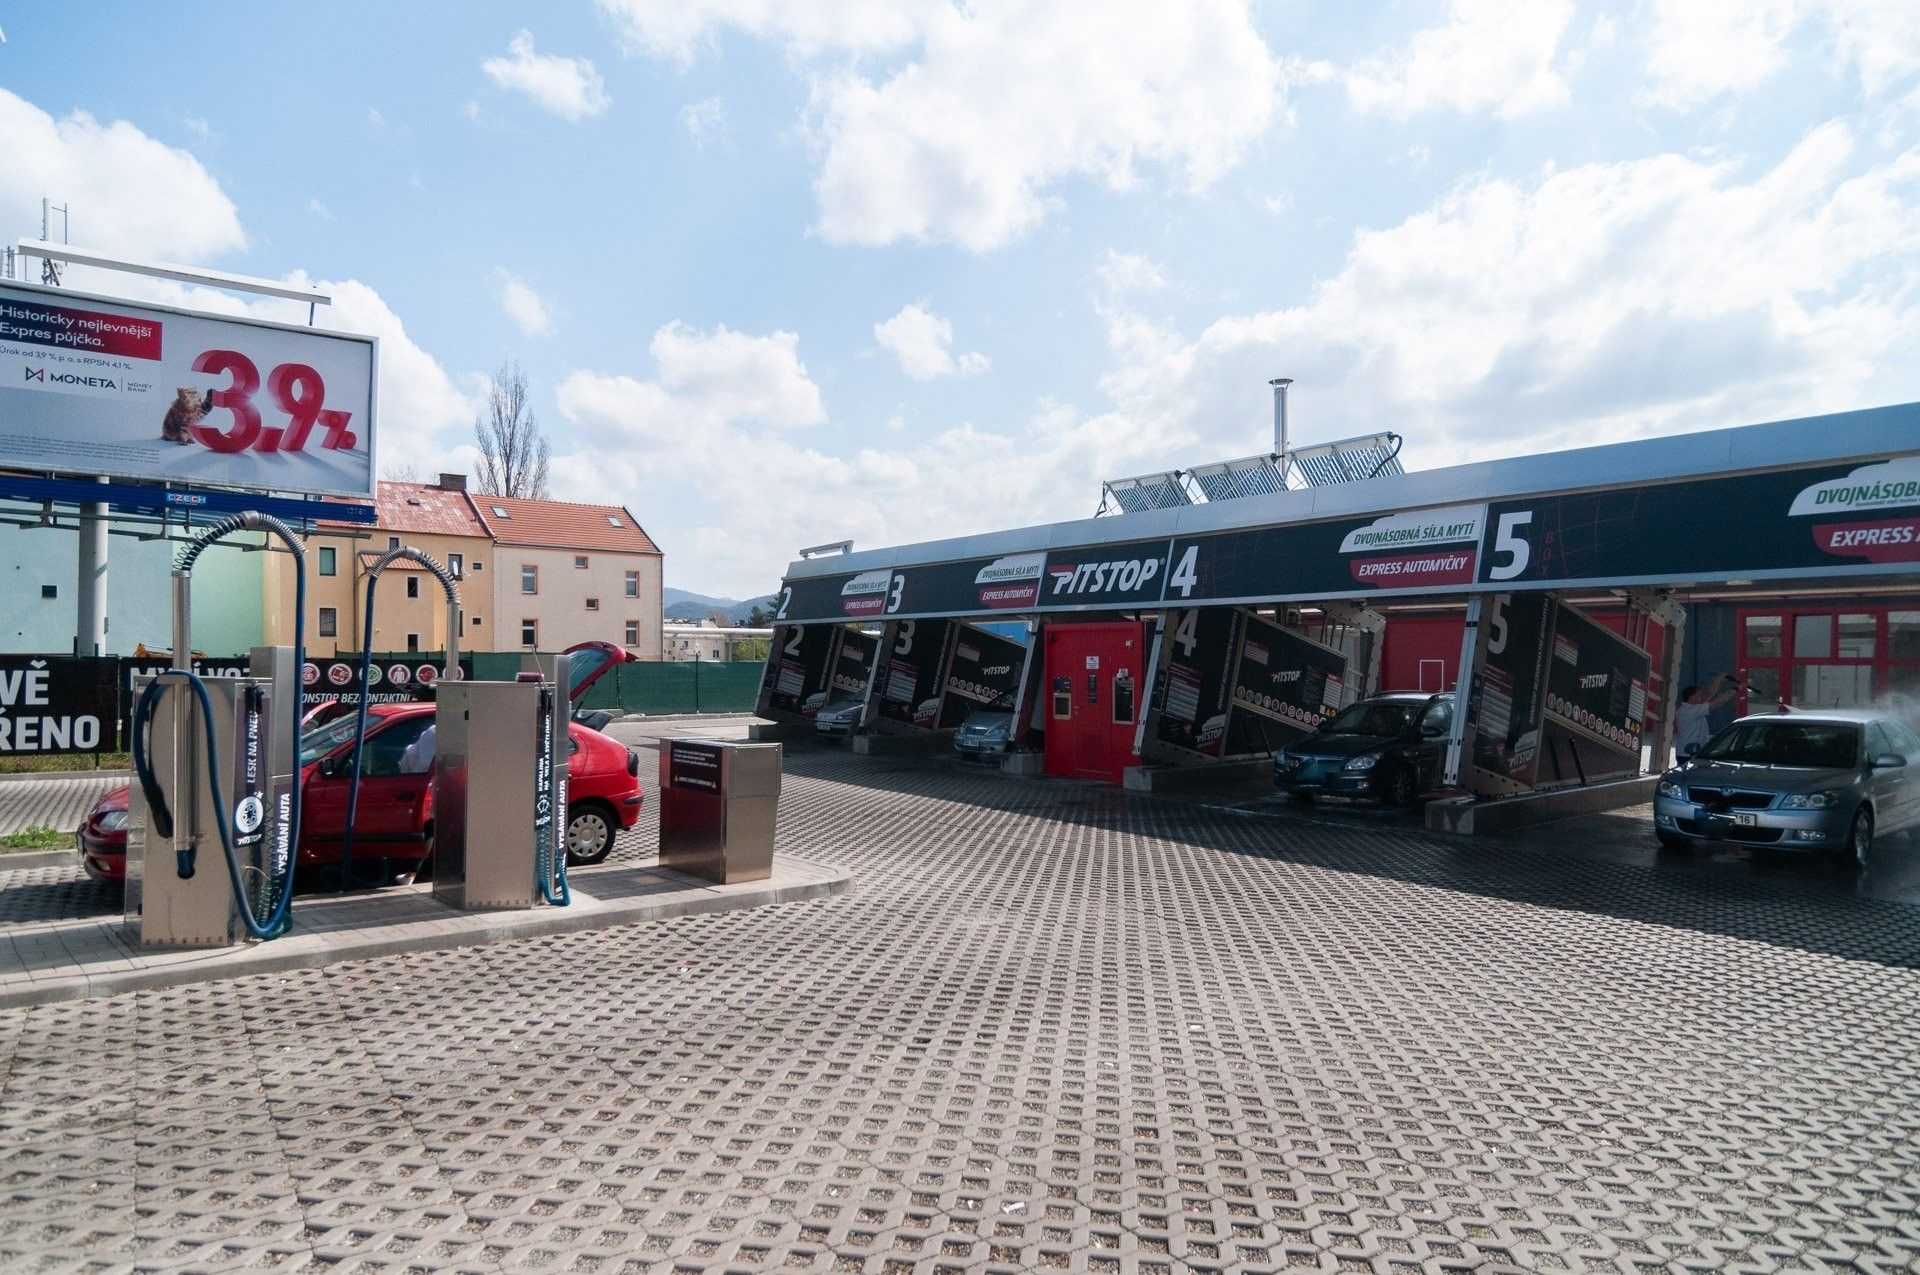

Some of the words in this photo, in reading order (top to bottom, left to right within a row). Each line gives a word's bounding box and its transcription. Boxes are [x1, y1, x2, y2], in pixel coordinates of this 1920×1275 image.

[0, 306, 75, 329] Historicky
[79, 319, 152, 339] nejlevnější
[0, 322, 51, 339] Expres
[55, 331, 105, 347] půjčka.
[22, 349, 34, 358] od
[83, 357, 110, 368] RPSN
[51, 372, 117, 390] MONETA
[167, 493, 206, 504] CZECH
[1814, 481, 1920, 506] DVOJNÁSOB
[1353, 525, 1421, 546] DVOJNÁSOBNÁ
[1421, 524, 1443, 539] SÍLA
[1446, 520, 1476, 536] MYTÍ
[1489, 510, 1533, 580] 5
[1829, 526, 1914, 548] EXPRESS
[1170, 545, 1199, 597] 4
[1358, 561, 1403, 577] EXPRESS
[1402, 555, 1468, 573] AUTOMYČKY
[776, 586, 793, 620] 2
[887, 574, 906, 614] 3
[982, 590, 1004, 601] EXPRESS
[1175, 607, 1199, 657] 4
[1487, 593, 1512, 655] 5
[784, 625, 806, 656] 2
[894, 620, 917, 655] 3
[982, 665, 1010, 676] PITSTOP
[1270, 670, 1301, 683] PITSTOP
[1579, 673, 1608, 689] PITSTOP
[301, 693, 339, 704] ONSTOP
[1196, 727, 1223, 743] PITSTOP
[247, 741, 258, 757] NA
[1507, 748, 1535, 768] PITSTOP
[246, 758, 257, 784] LESK
[280, 793, 291, 821] AUTA
[277, 823, 290, 875] VYSÁVÁNÍ
